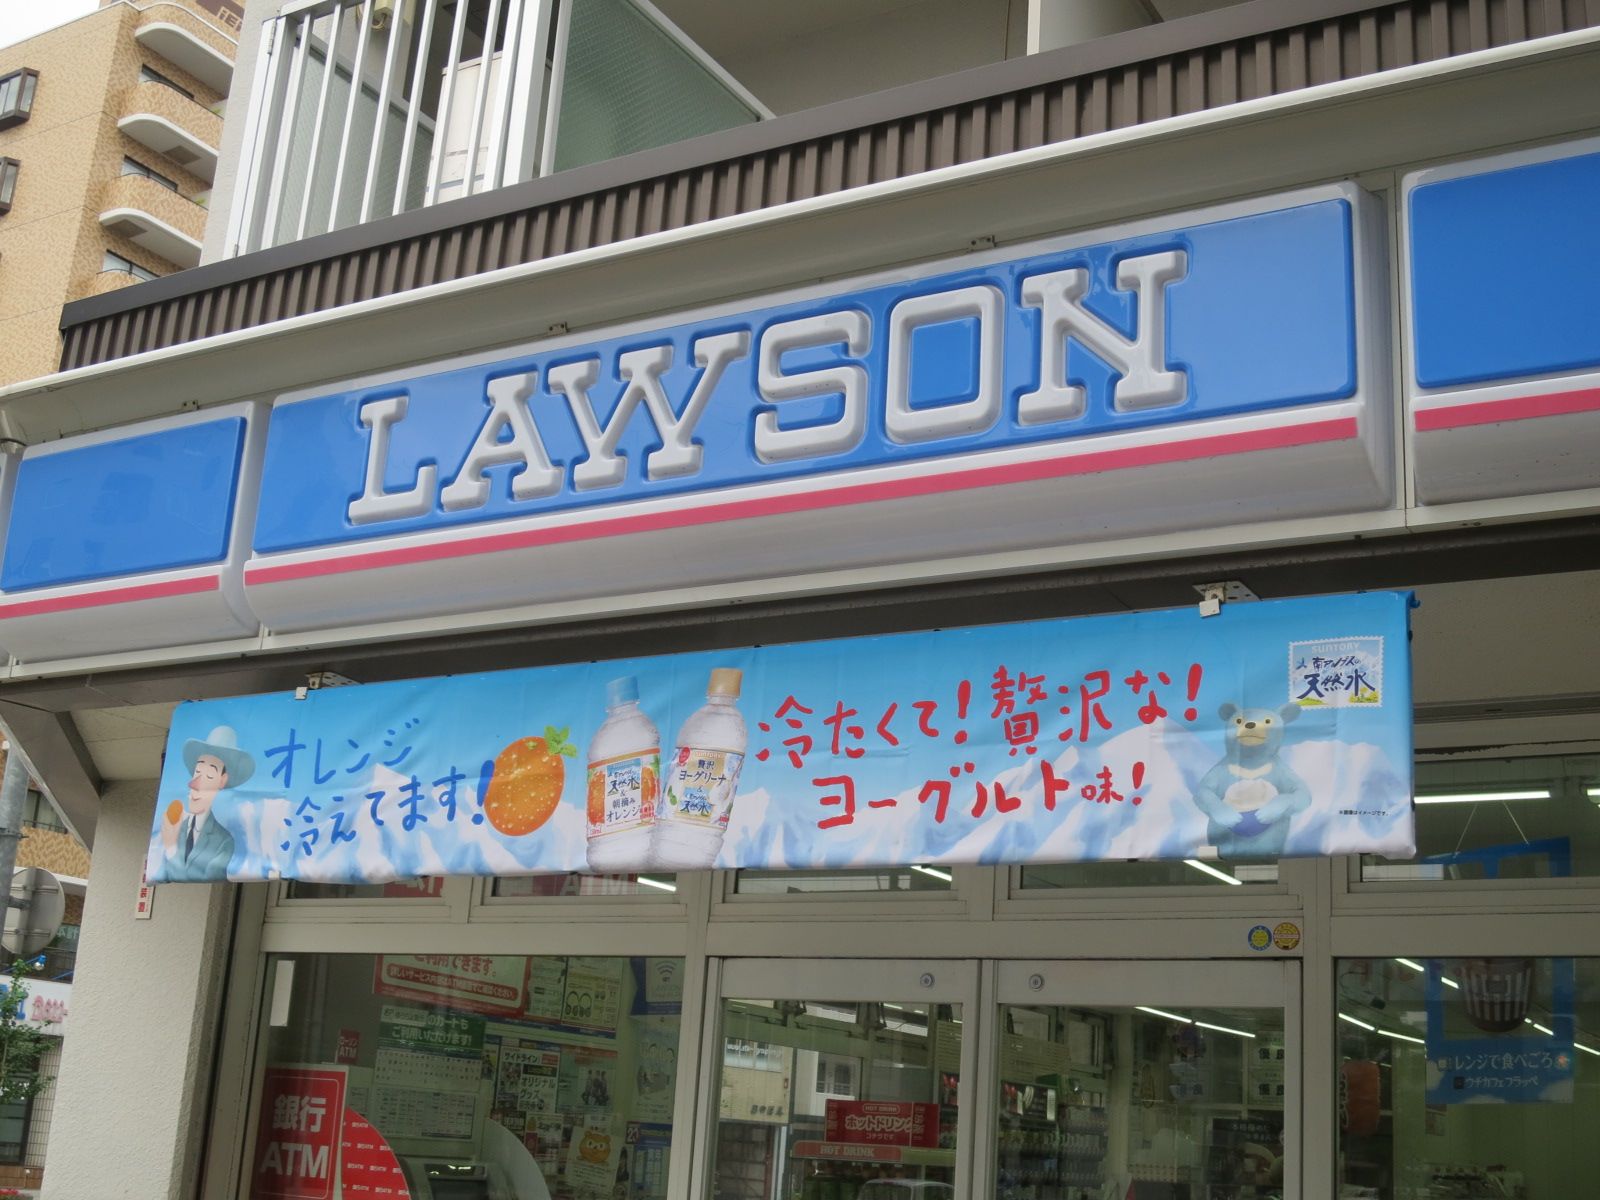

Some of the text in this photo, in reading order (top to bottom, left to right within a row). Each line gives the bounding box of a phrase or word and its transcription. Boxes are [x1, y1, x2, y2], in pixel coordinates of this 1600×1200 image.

[347, 249, 1189, 527] LAWSON
[1297, 669, 1376, 699] 天然水
[264, 717, 420, 788] オレンジ
[679, 770, 727, 786] ヨーグリーナ
[812, 760, 1145, 829] ヨーグルト味!
[280, 759, 495, 856] 冷えてます!
[606, 805, 642, 822] オレンジ
[272, 1094, 328, 1133] 銀行
[260, 1140, 330, 1179] ATM
[820, 1145, 839, 1155] HOT
